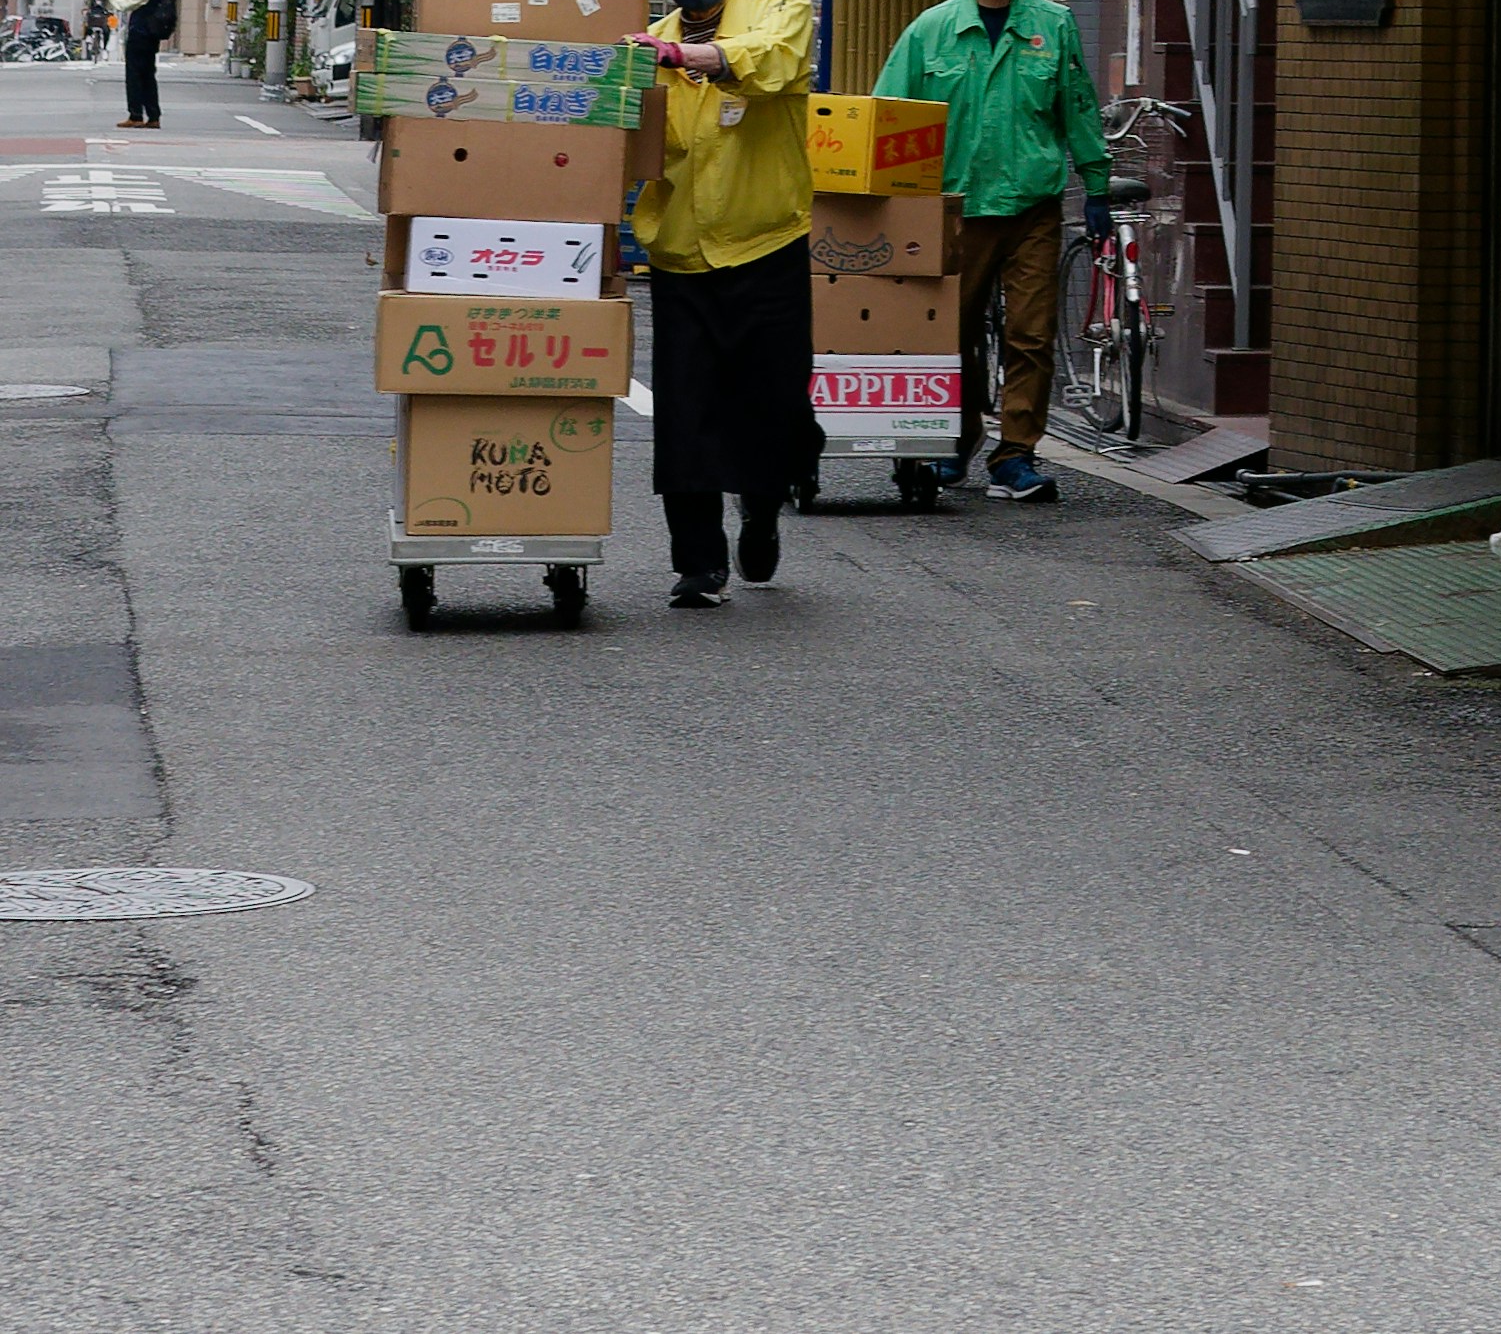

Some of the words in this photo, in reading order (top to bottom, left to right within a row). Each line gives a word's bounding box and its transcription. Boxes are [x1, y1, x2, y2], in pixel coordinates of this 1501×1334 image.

[529, 43, 617, 77] 白ねぎ
[514, 84, 599, 118] 白ねぎ
[469, 248, 545, 267] オクラ
[467, 332, 609, 369] セルリー
[810, 374, 951, 406] APPLES
[559, 417, 607, 437] なす
[471, 436, 552, 466] KUMA
[470, 467, 552, 496] MOTO
